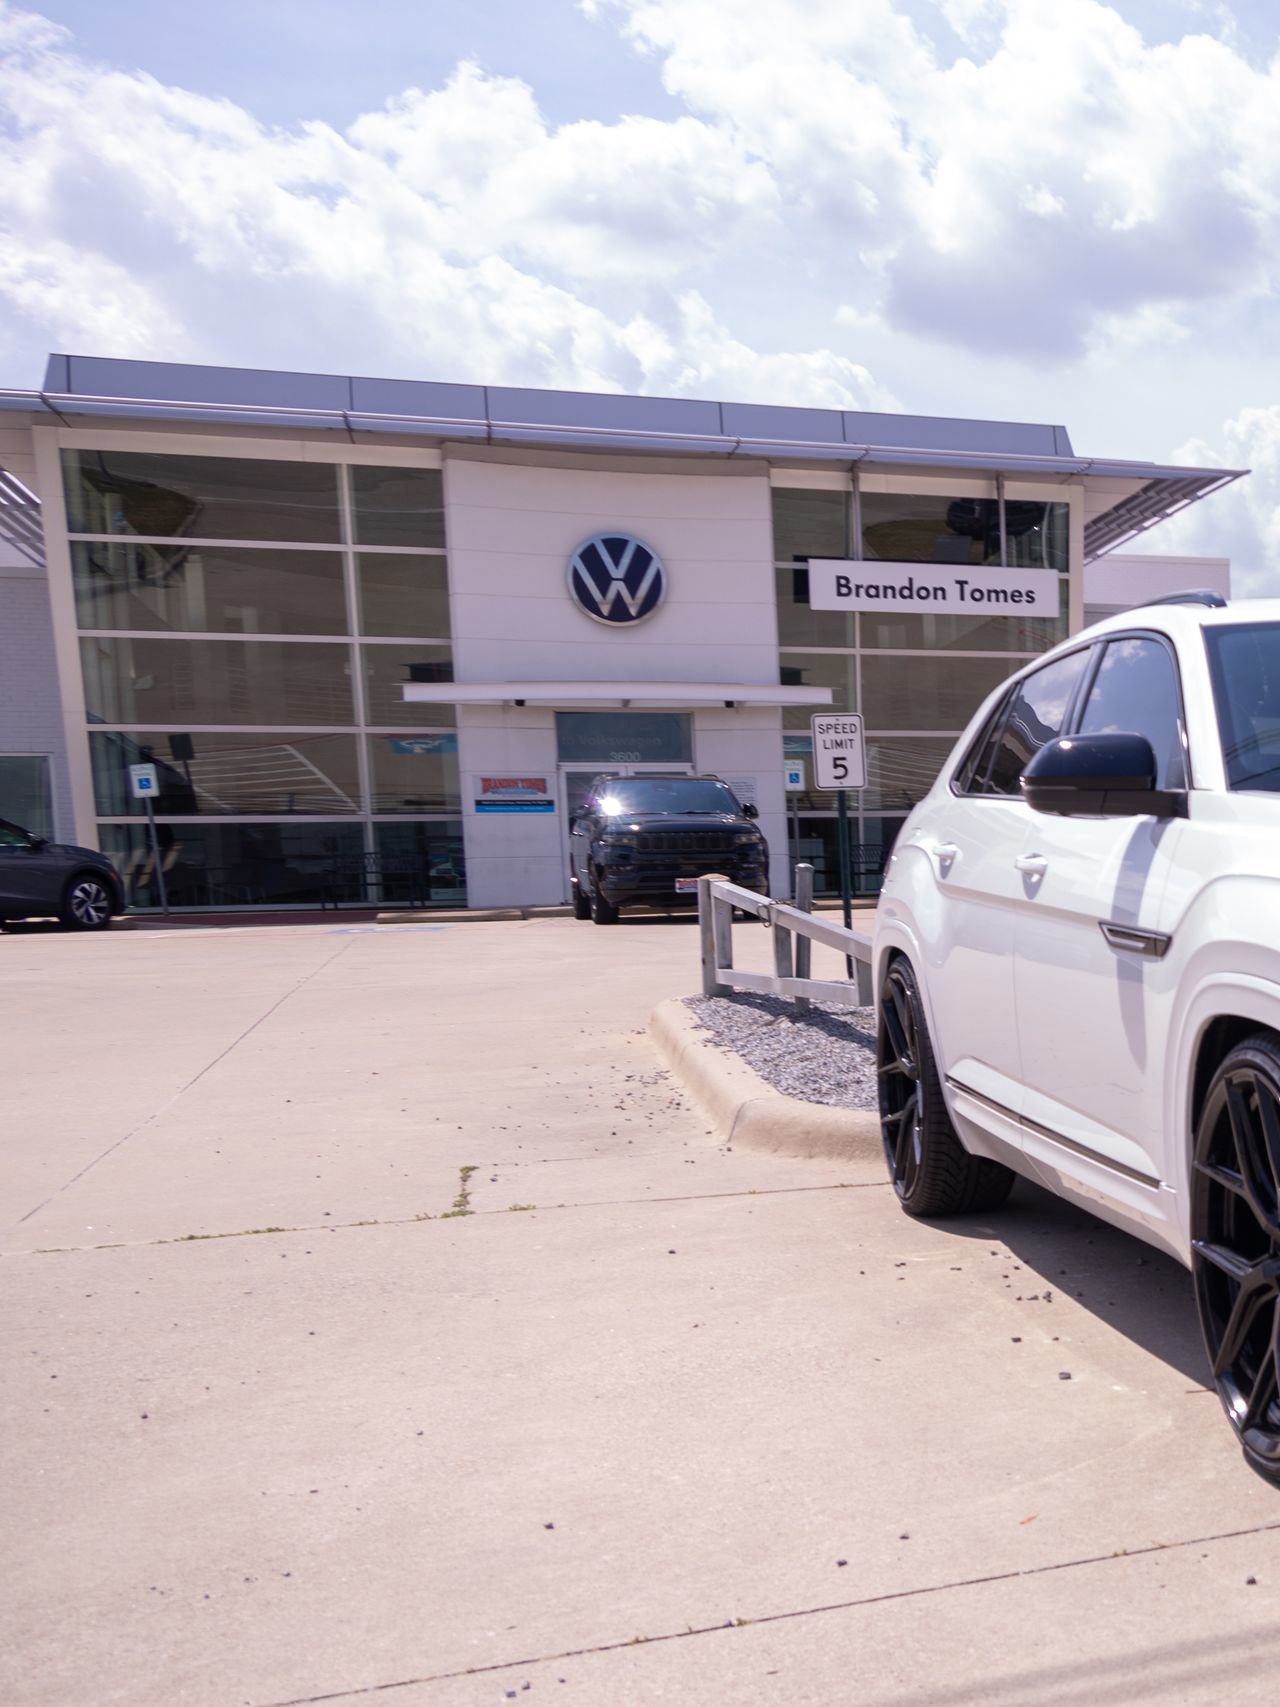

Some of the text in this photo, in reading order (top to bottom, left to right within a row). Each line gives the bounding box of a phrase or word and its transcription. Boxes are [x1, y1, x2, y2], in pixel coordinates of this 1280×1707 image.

[569, 534, 663, 620] VW
[835, 575, 1036, 604] Brandon Tomes
[818, 723, 858, 735] SPEED
[823, 738, 855, 750] LIMIT
[609, 751, 641, 762] 3600
[832, 756, 849, 780] 5
